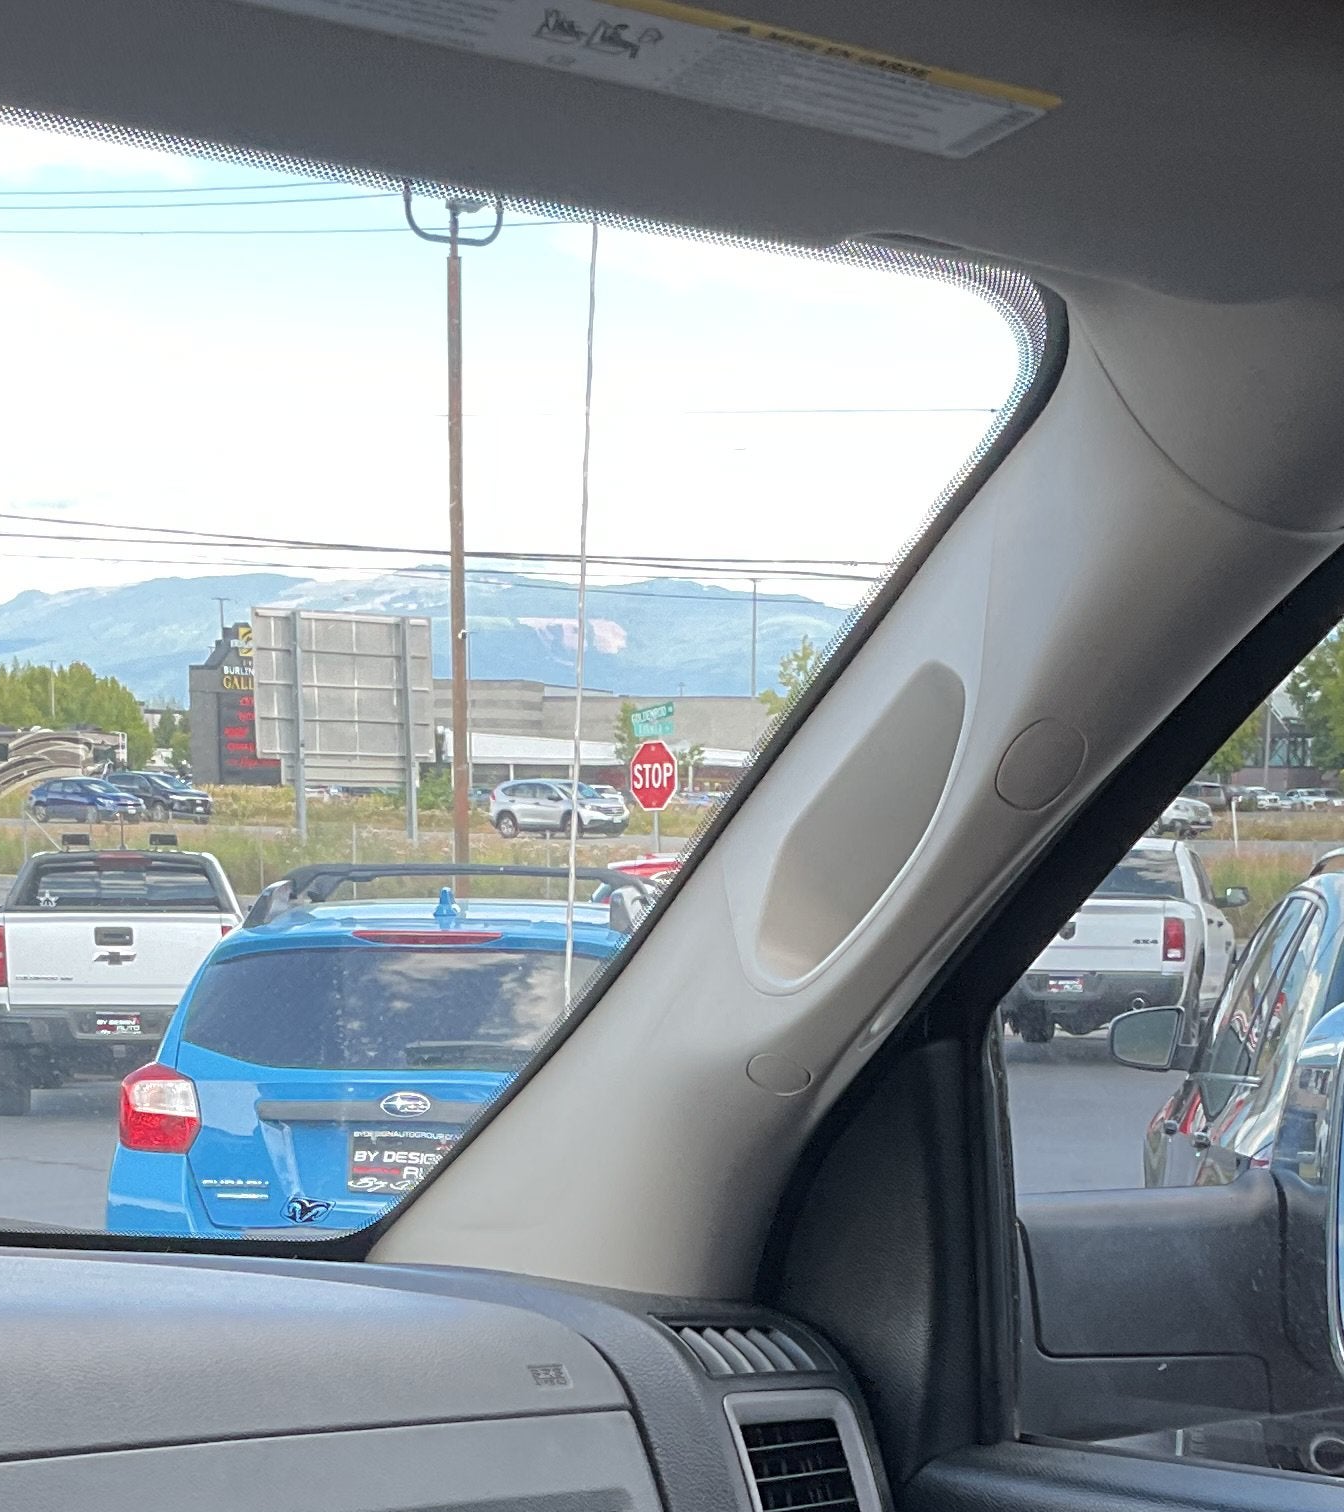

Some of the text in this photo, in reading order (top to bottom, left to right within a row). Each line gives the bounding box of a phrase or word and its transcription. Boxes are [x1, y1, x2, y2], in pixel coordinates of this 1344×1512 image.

[223, 665, 255, 676] BURLIN
[223, 676, 254, 689] GALL
[633, 762, 673, 789] STOP
[354, 1150, 443, 1165] BY DESIG
